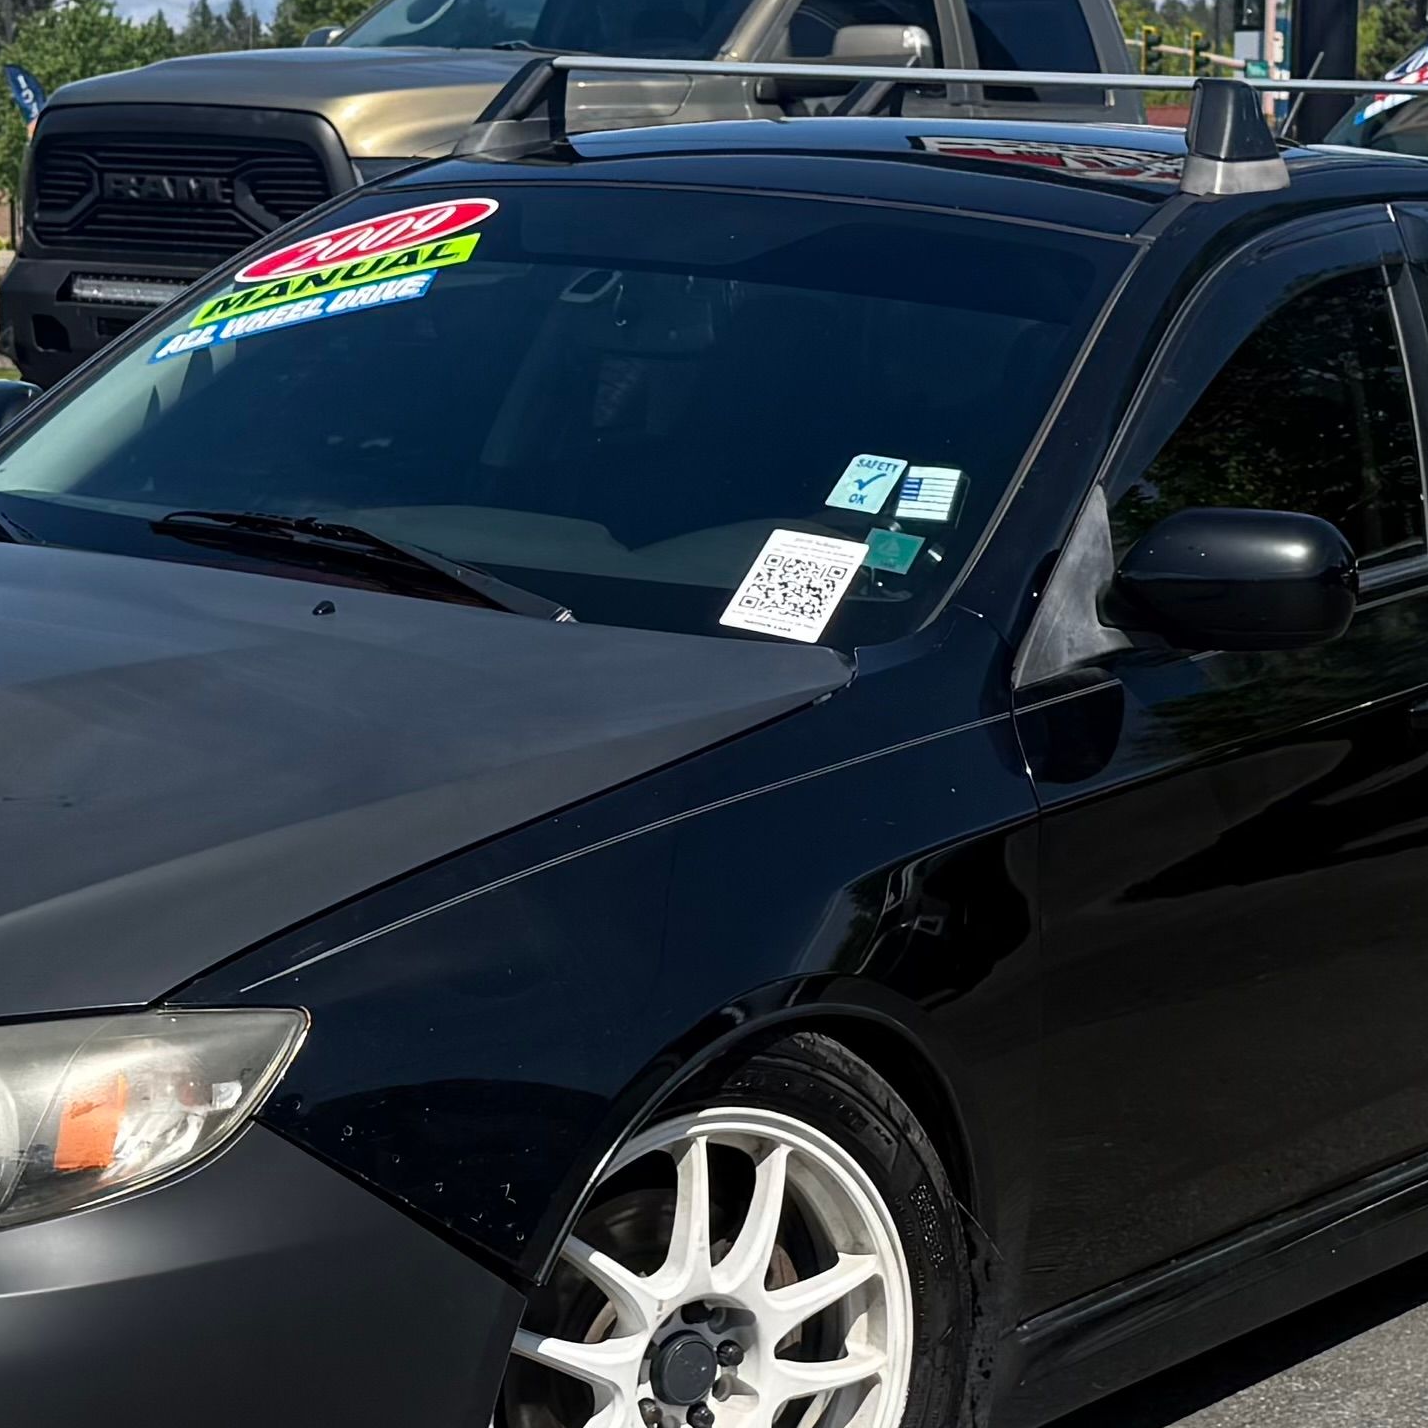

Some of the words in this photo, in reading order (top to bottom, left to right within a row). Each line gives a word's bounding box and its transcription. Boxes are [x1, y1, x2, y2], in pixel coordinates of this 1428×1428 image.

[103, 172, 220, 202] RAM
[269, 205, 457, 276] 2009
[201, 241, 461, 319] MANUAL
[155, 325, 214, 360] ALL
[218, 298, 327, 339] WHEEL
[325, 274, 431, 314] DRIVE
[857, 458, 899, 473] SAFETY
[848, 493, 868, 505] OK
